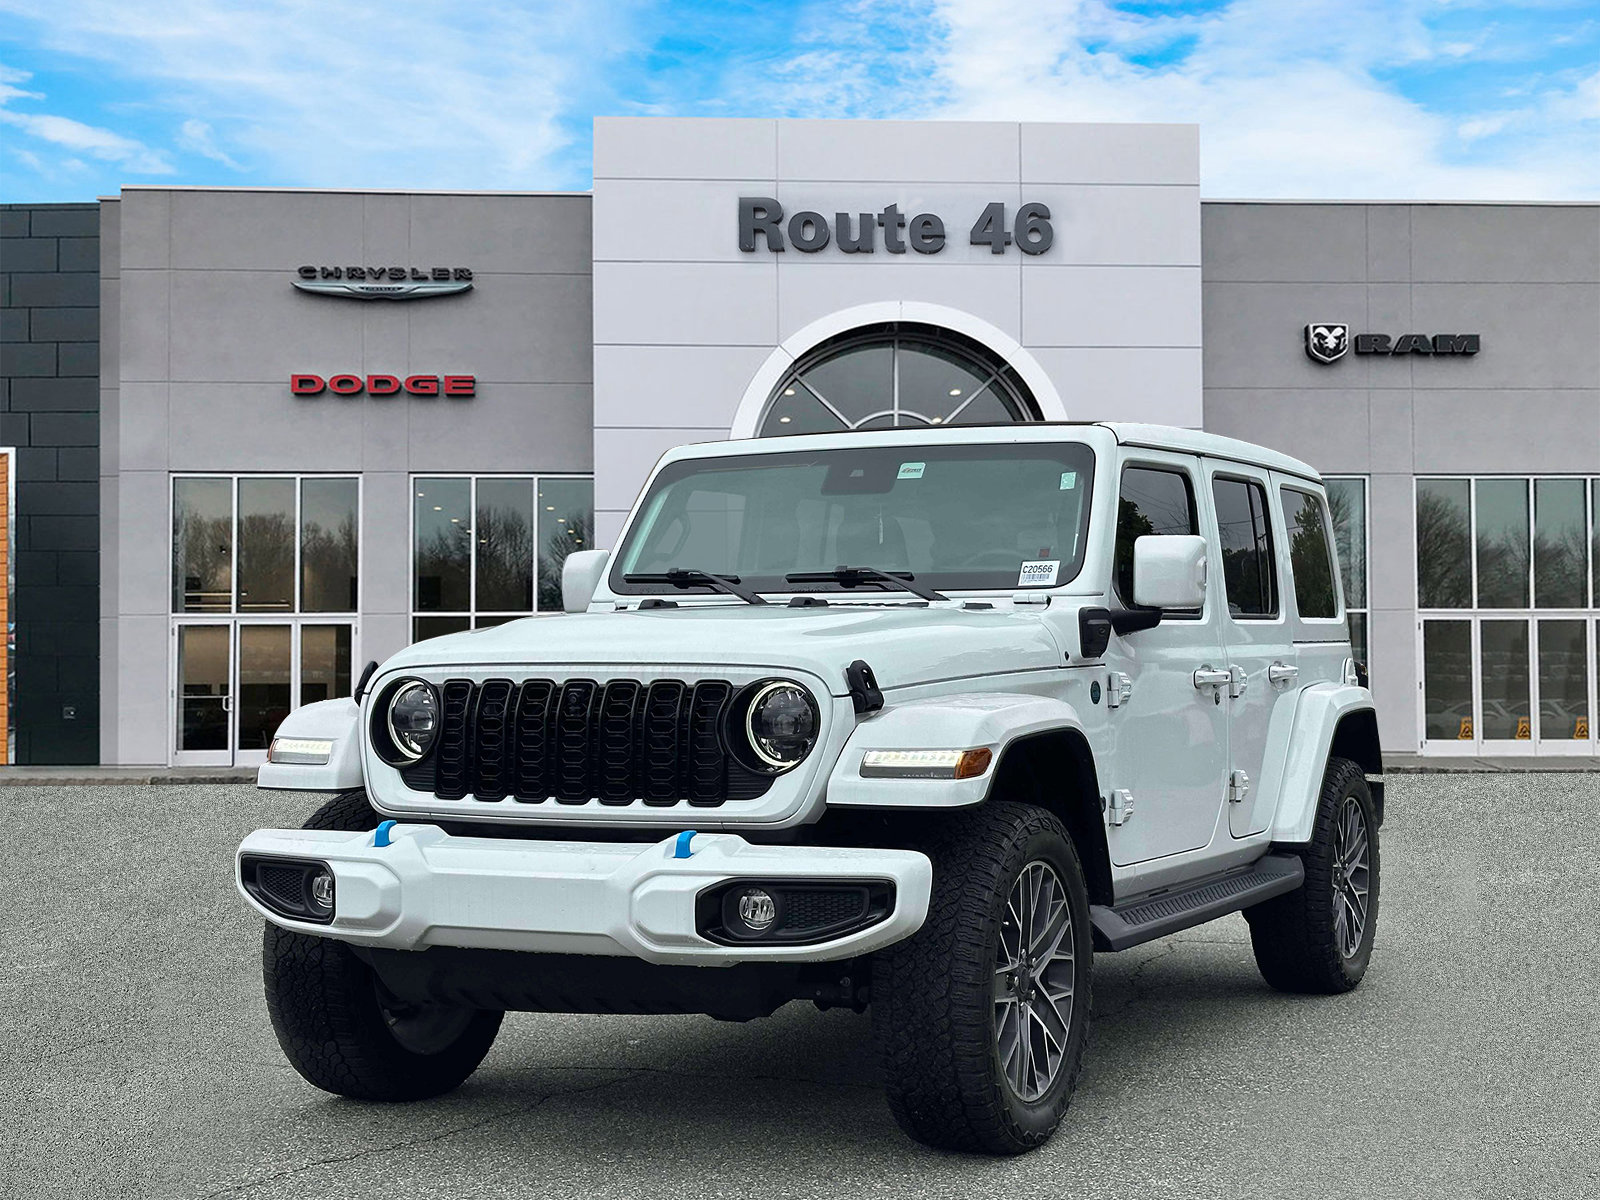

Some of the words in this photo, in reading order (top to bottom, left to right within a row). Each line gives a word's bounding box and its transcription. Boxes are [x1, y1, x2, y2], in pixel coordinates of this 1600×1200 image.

[738, 196, 946, 255] Route
[970, 201, 1054, 255] 46
[298, 266, 473, 281] CHRYSLER
[1354, 334, 1480, 356] RAM
[291, 374, 476, 396] DODGE
[1022, 564, 1054, 574] C20566
